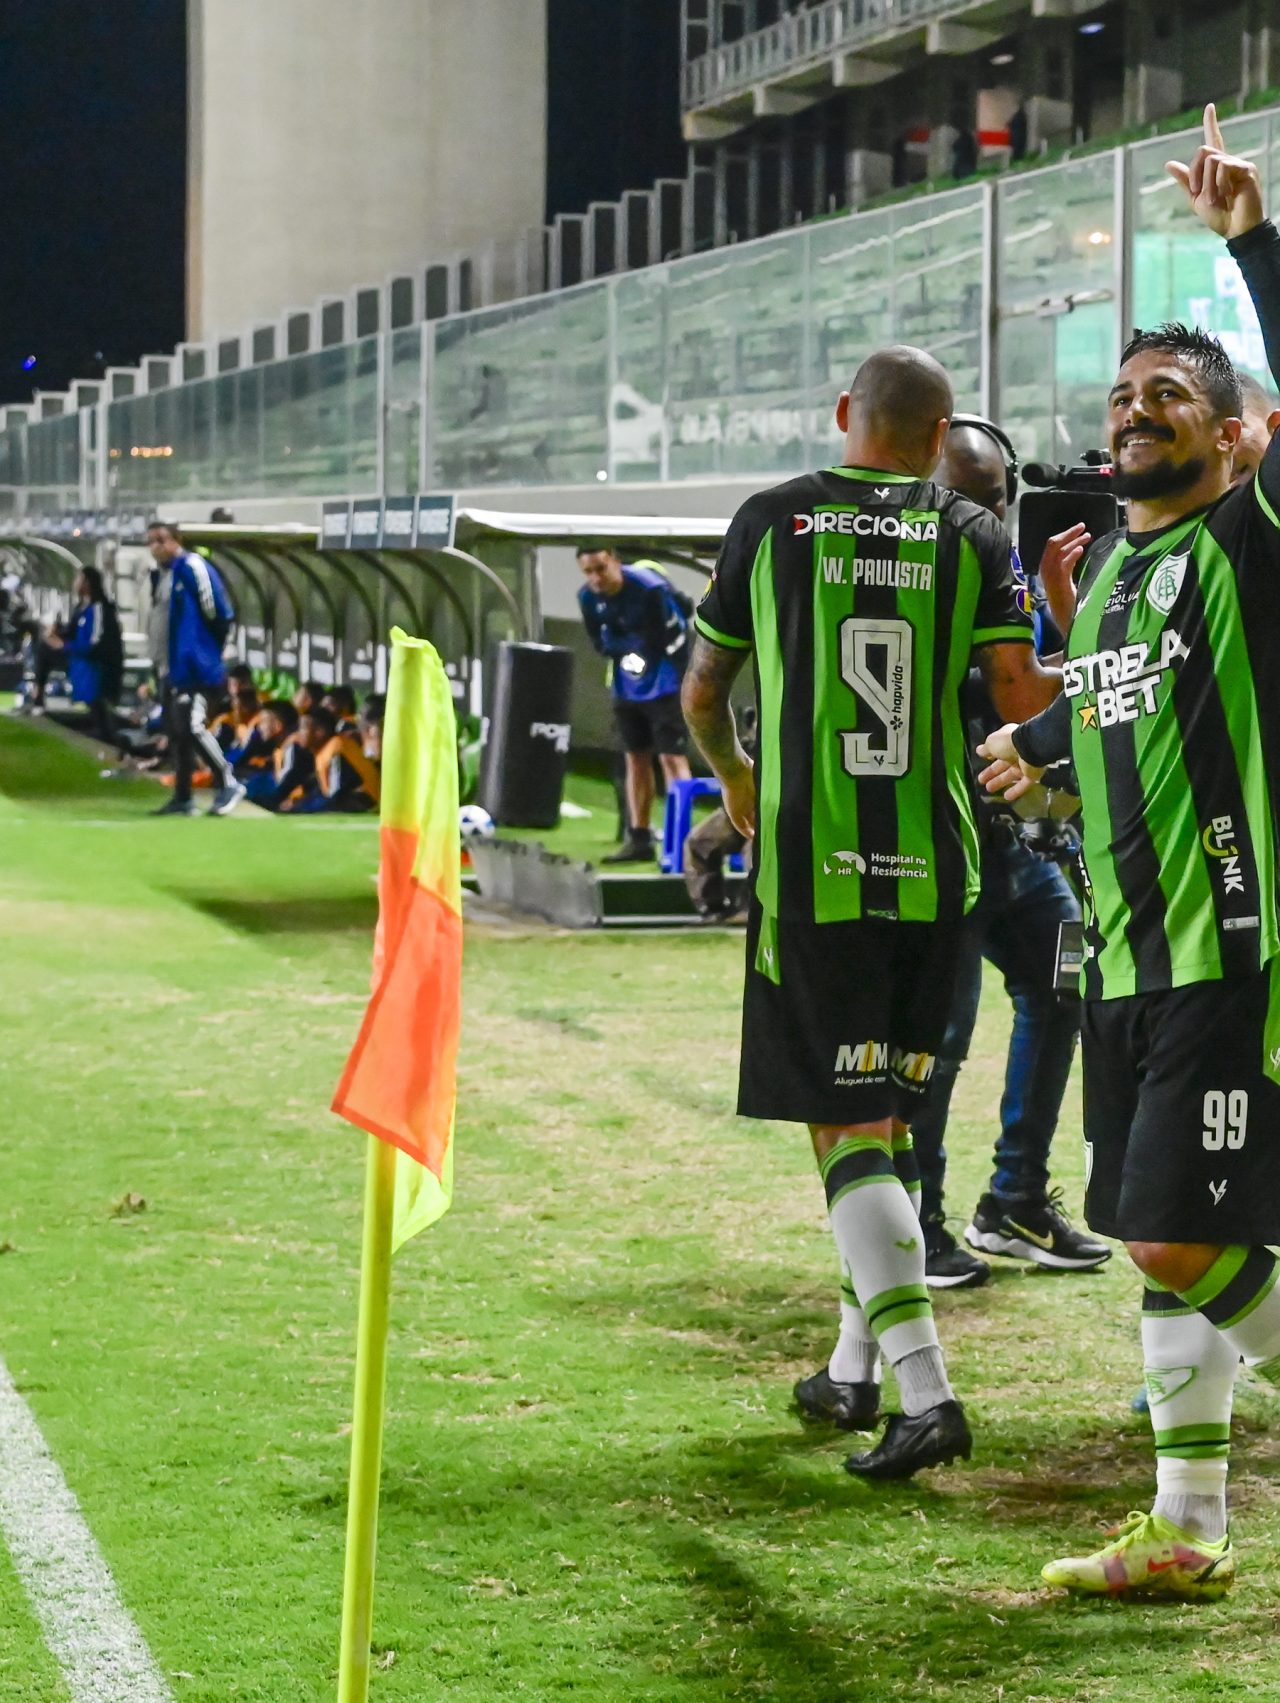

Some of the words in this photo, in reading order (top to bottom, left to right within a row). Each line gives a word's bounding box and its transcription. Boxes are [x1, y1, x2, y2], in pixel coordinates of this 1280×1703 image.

[822, 556, 847, 585] W.
[852, 558, 933, 591] PAULISTA
[1062, 628, 1191, 698] ESTRELA
[840, 617, 912, 776] 9
[892, 665, 905, 714] hapvida
[1097, 674, 1161, 728] BET
[837, 867, 852, 876] HR
[871, 853, 913, 865] Hospital
[916, 857, 927, 865] na
[1202, 1089, 1249, 1151] 99
